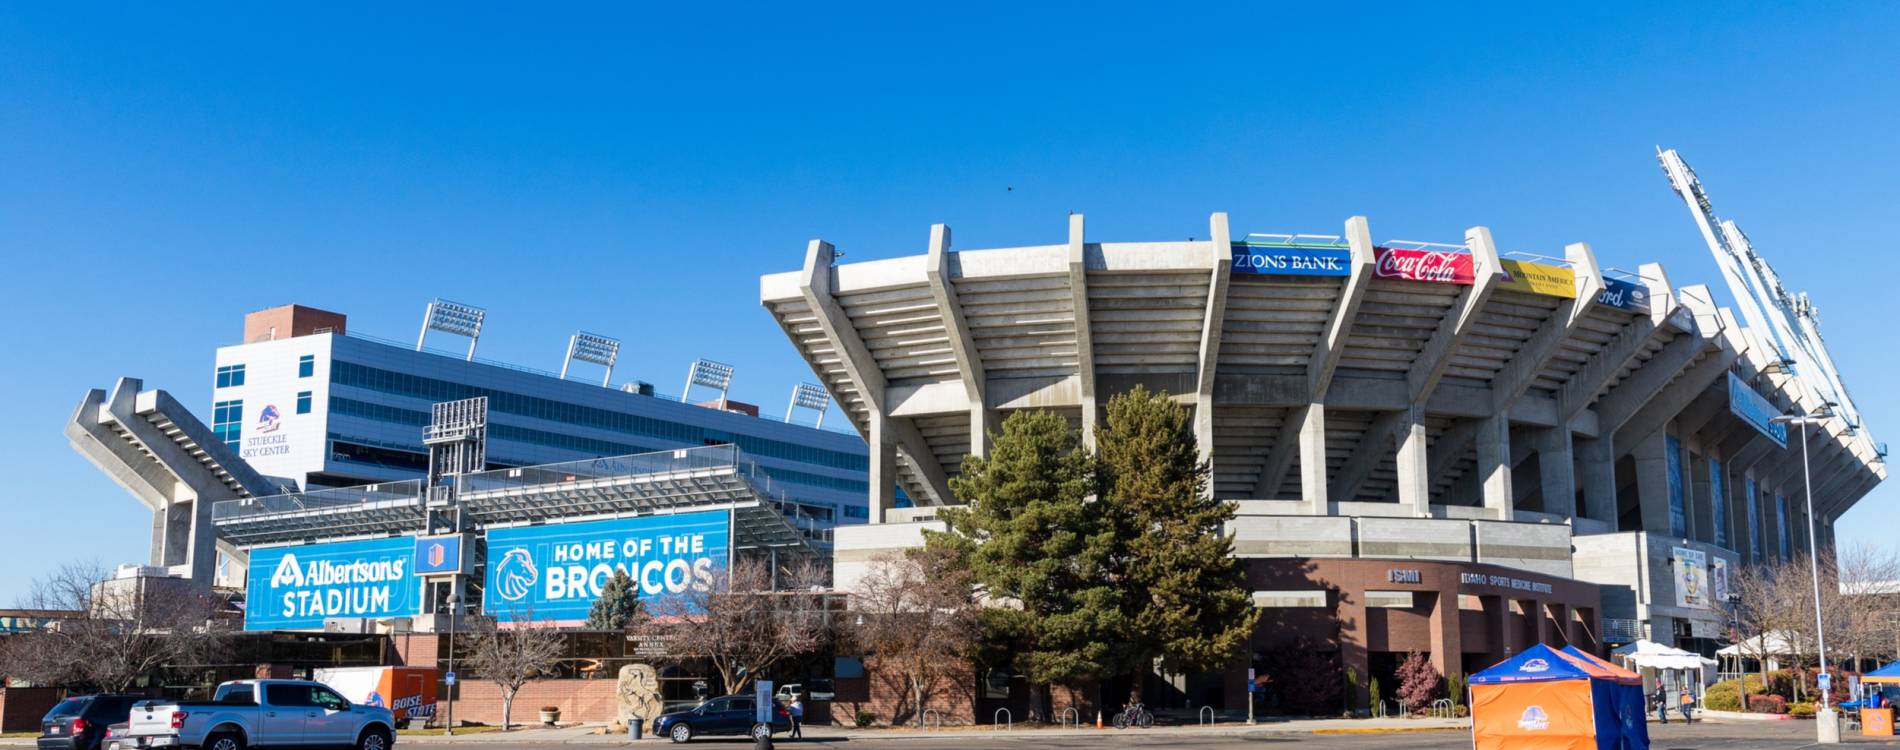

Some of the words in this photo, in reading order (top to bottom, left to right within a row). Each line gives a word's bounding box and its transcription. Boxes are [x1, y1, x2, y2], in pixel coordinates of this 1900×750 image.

[1234, 254, 1287, 269] ZIONS
[1376, 248, 1459, 281] Coca-Cola
[1513, 270, 1546, 281] MOUNTAIN
[1599, 281, 1623, 307] ord
[248, 434, 287, 446] STUECKLE
[243, 448, 258, 458] SKY
[260, 445, 290, 456] CENTER
[555, 541, 615, 562] HOME
[623, 538, 652, 557] OF
[660, 535, 704, 555] THE
[305, 558, 404, 587] Albertsons
[1461, 572, 1487, 584] IDAHO
[1489, 575, 1511, 588] SPORTS
[282, 586, 389, 618] STADIUM
[393, 696, 422, 710] BOISE
[407, 703, 436, 718] STATE
